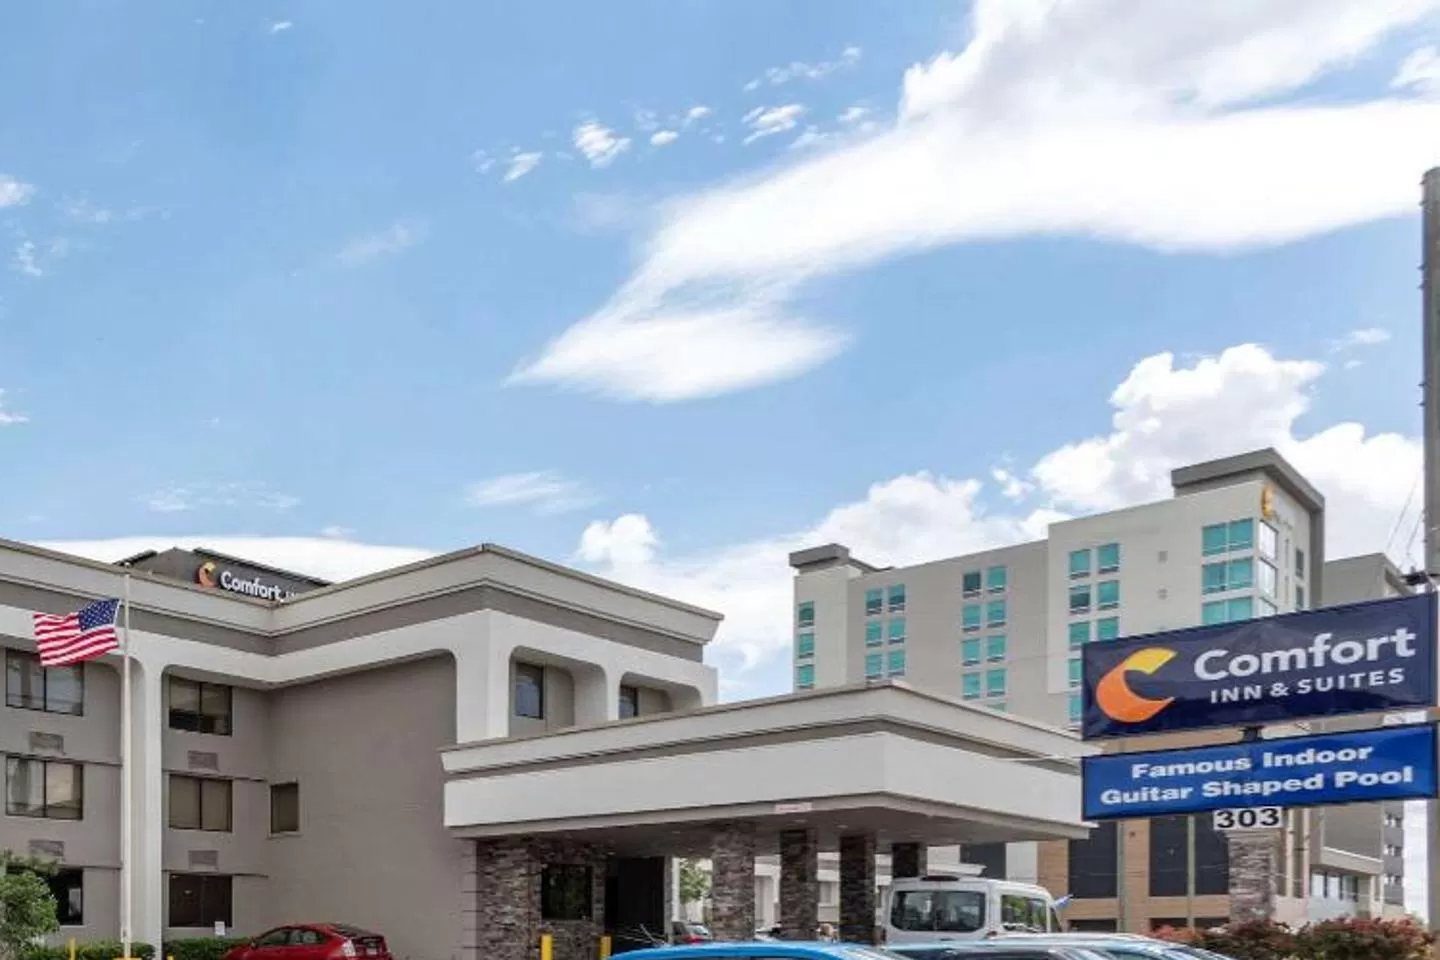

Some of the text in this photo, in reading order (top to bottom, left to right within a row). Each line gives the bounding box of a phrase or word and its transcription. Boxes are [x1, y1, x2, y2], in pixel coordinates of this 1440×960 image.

[221, 571, 281, 600] Comfort
[1193, 627, 1416, 681] Comfort
[1211, 667, 1406, 703] INN & SUITES
[1131, 745, 1375, 779] Famous Indoor
[1100, 766, 1414, 805] Guitar Shaped Pool
[1216, 807, 1280, 829] 303
